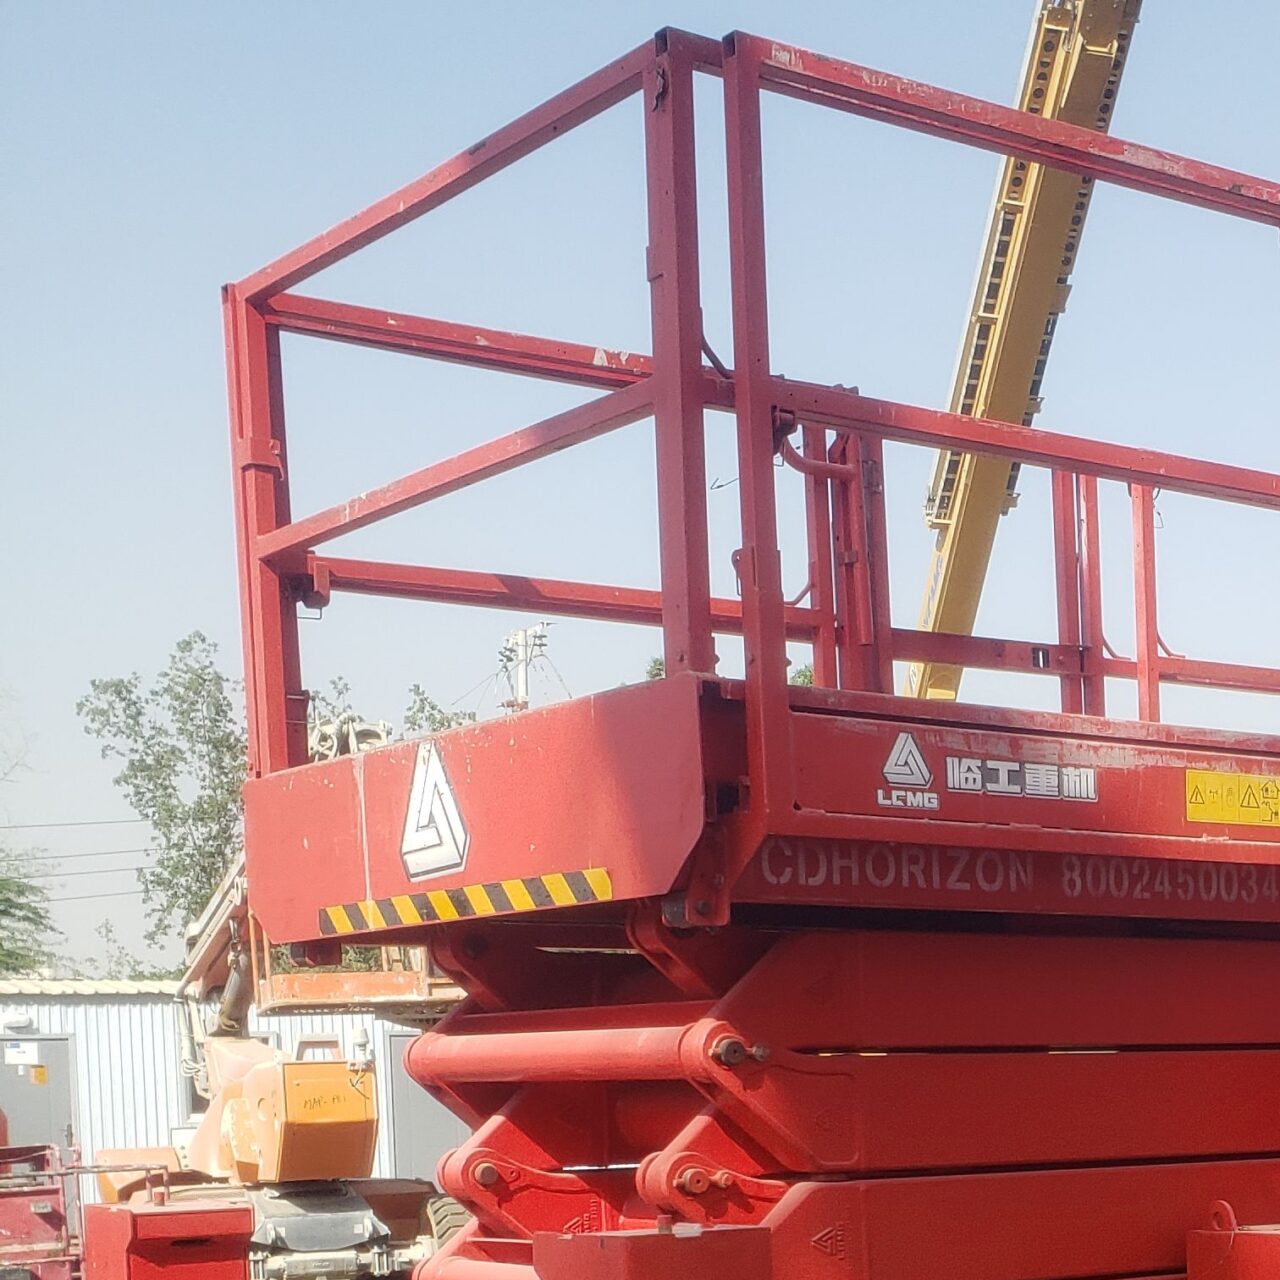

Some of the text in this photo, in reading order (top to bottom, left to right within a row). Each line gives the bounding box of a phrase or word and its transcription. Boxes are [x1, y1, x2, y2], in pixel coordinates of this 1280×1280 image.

[946, 756, 1097, 799] 临工重机
[760, 840, 1280, 902] CDHORIZON 8002450034
